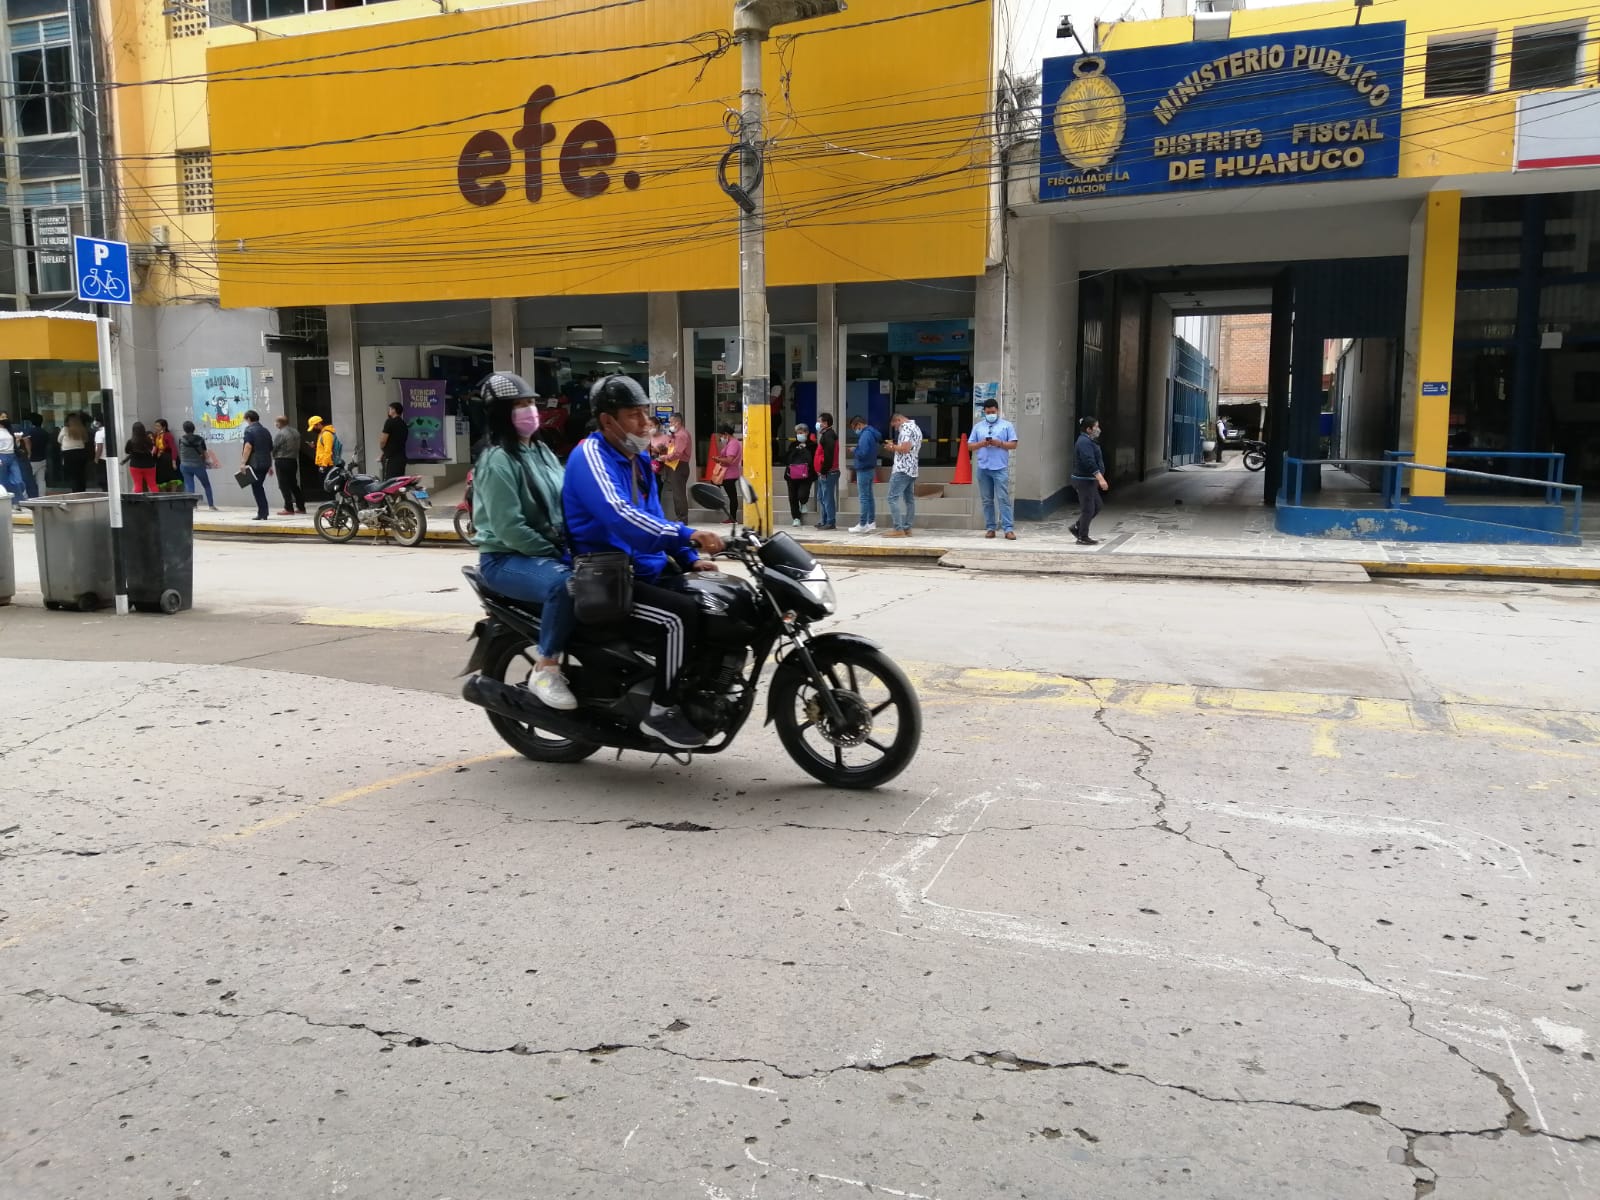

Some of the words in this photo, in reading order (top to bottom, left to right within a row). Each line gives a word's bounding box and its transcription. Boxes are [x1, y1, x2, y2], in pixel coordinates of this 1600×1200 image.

[1152, 45, 1286, 126] MINISTERIO
[1292, 45, 1391, 107] PUBLICO
[1154, 128, 1263, 157] DISTRITO
[1292, 119, 1385, 144] FISCAL
[1048, 174, 1097, 187] FISCALIA
[1115, 171, 1130, 181] LA
[1168, 159, 1206, 182] DE
[1215, 147, 1366, 178] HUANUCO
[1068, 183, 1107, 195] NACION
[94, 243, 109, 266] P
